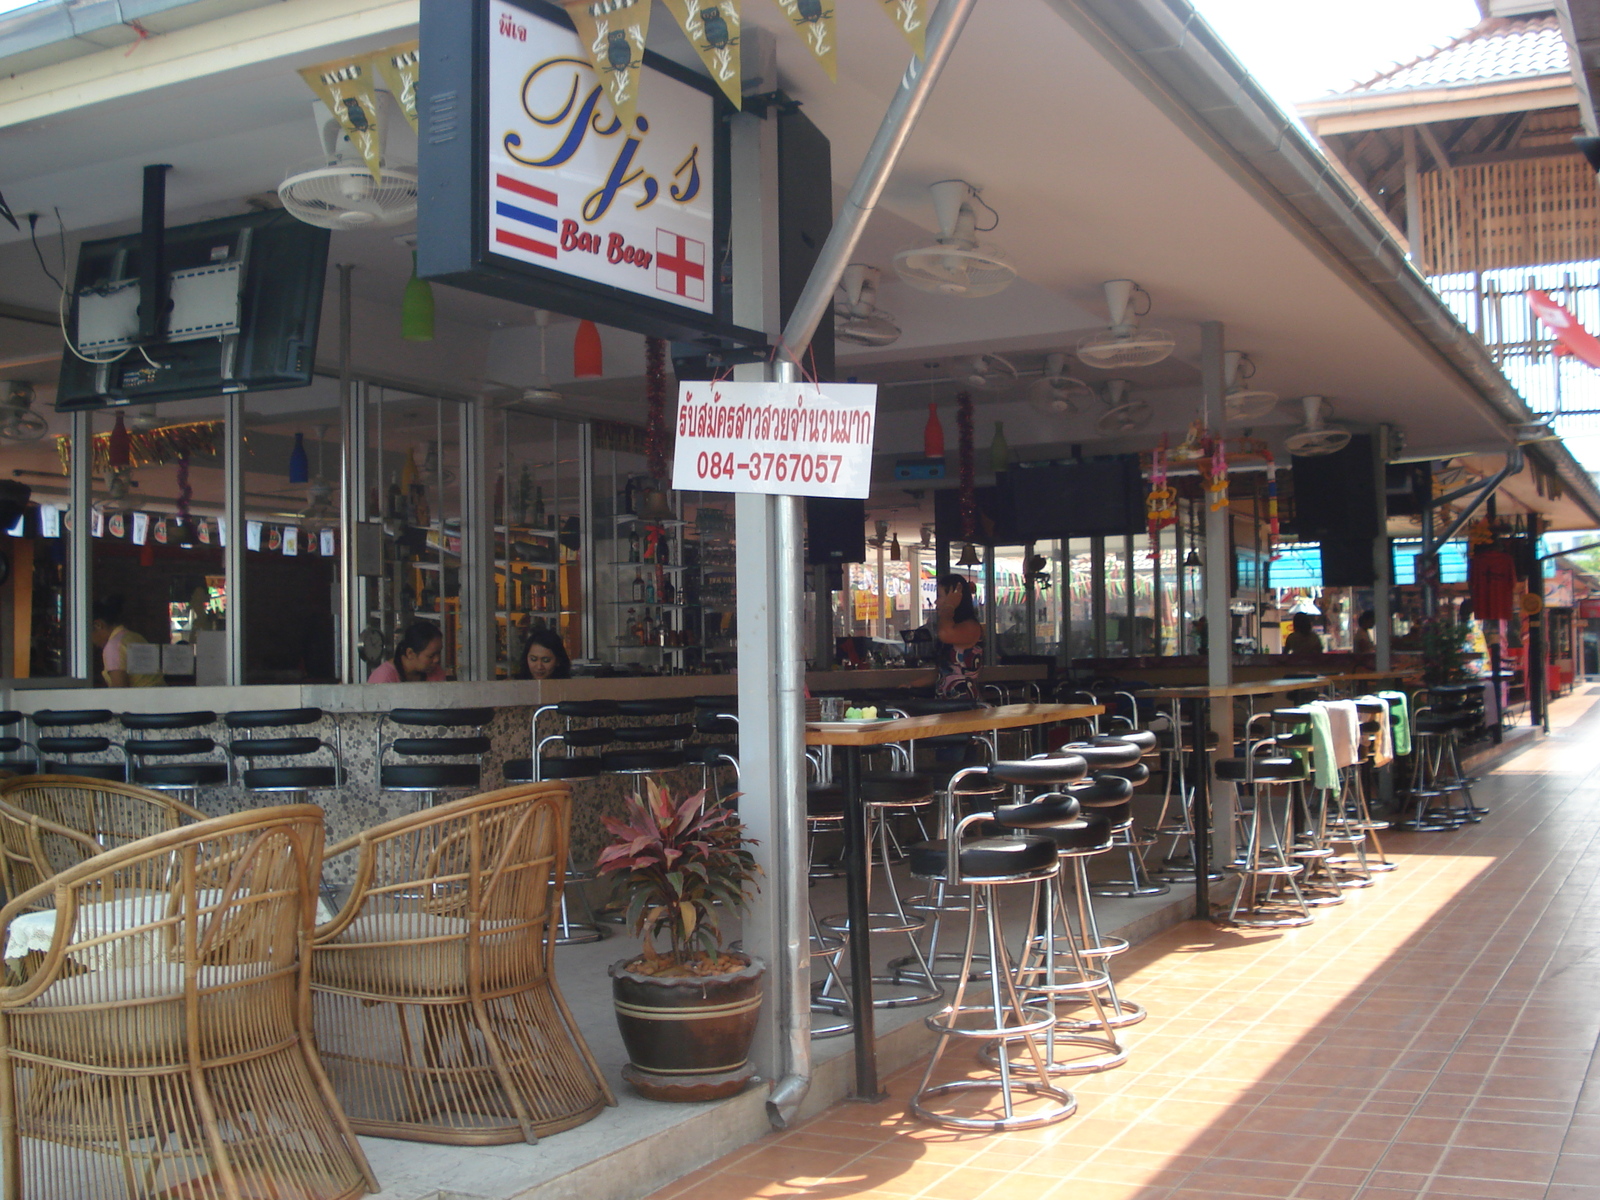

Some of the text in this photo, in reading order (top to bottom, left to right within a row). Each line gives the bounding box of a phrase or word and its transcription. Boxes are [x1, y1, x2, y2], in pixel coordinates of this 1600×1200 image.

[560, 219, 653, 270] Bar Beer
[679, 390, 871, 445] รับสมัครสาวสวยจำนวนมาก
[697, 451, 843, 483] 084-3767057
